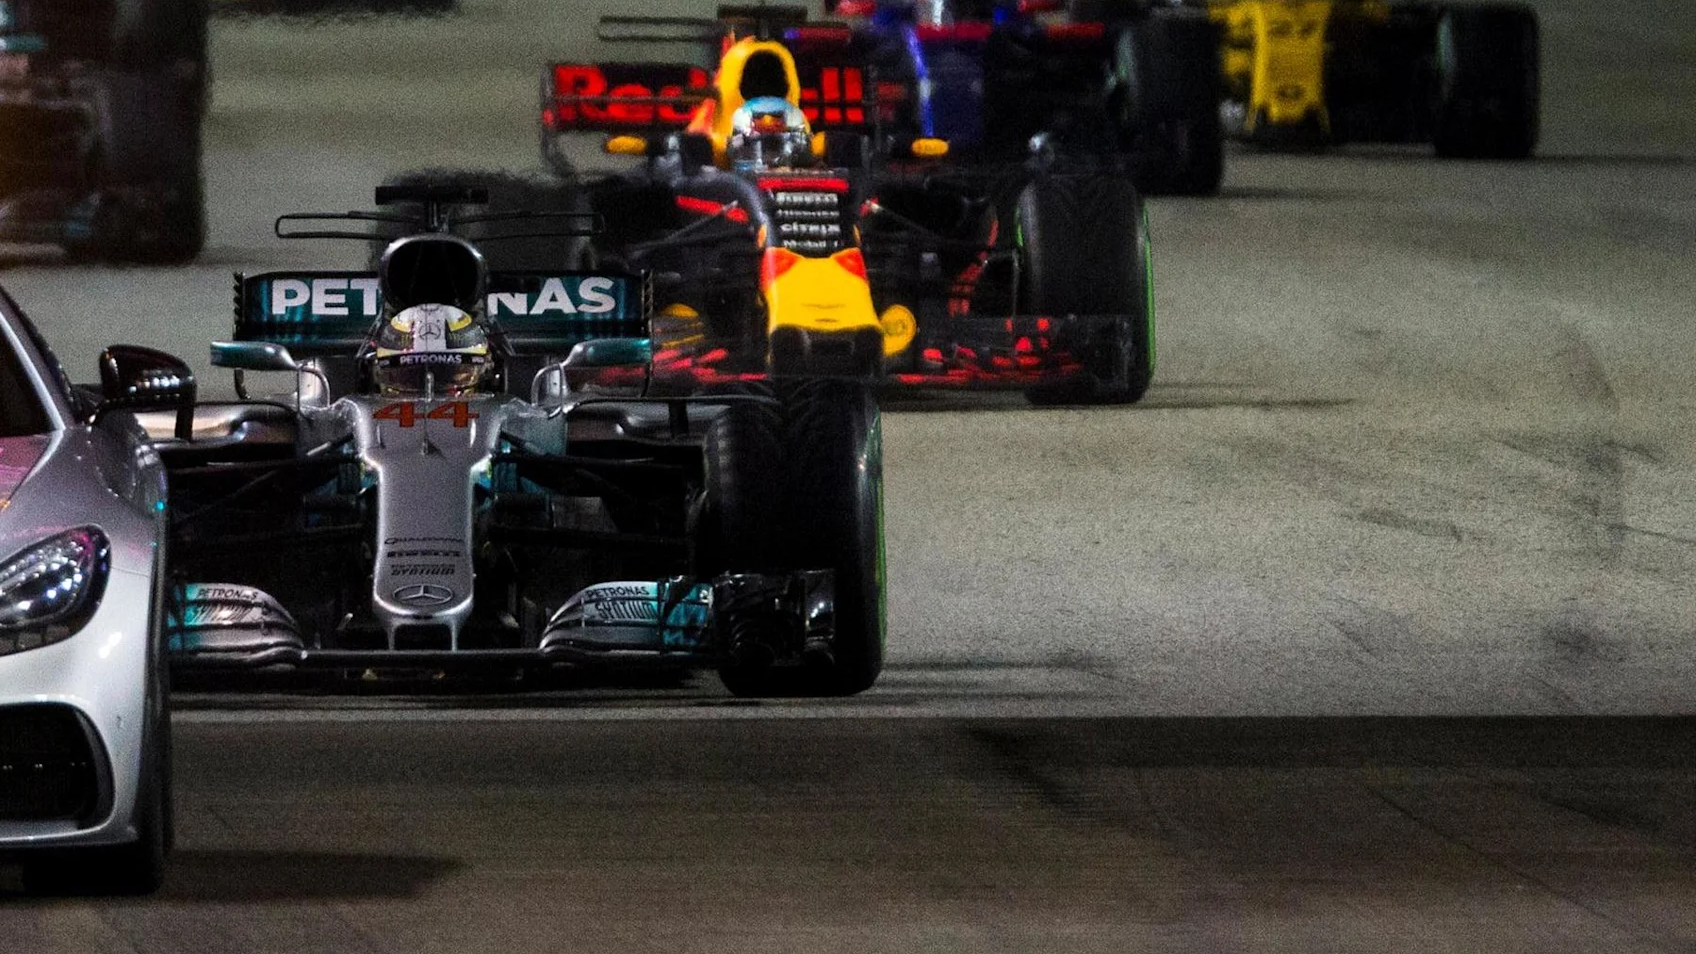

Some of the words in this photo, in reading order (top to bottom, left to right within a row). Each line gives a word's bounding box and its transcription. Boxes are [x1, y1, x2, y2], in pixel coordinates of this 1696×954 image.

[270, 276, 616, 316] PETNAS
[399, 354, 462, 365] PETRONAS
[372, 401, 479, 428] 44
[587, 586, 650, 599] PETRONAS
